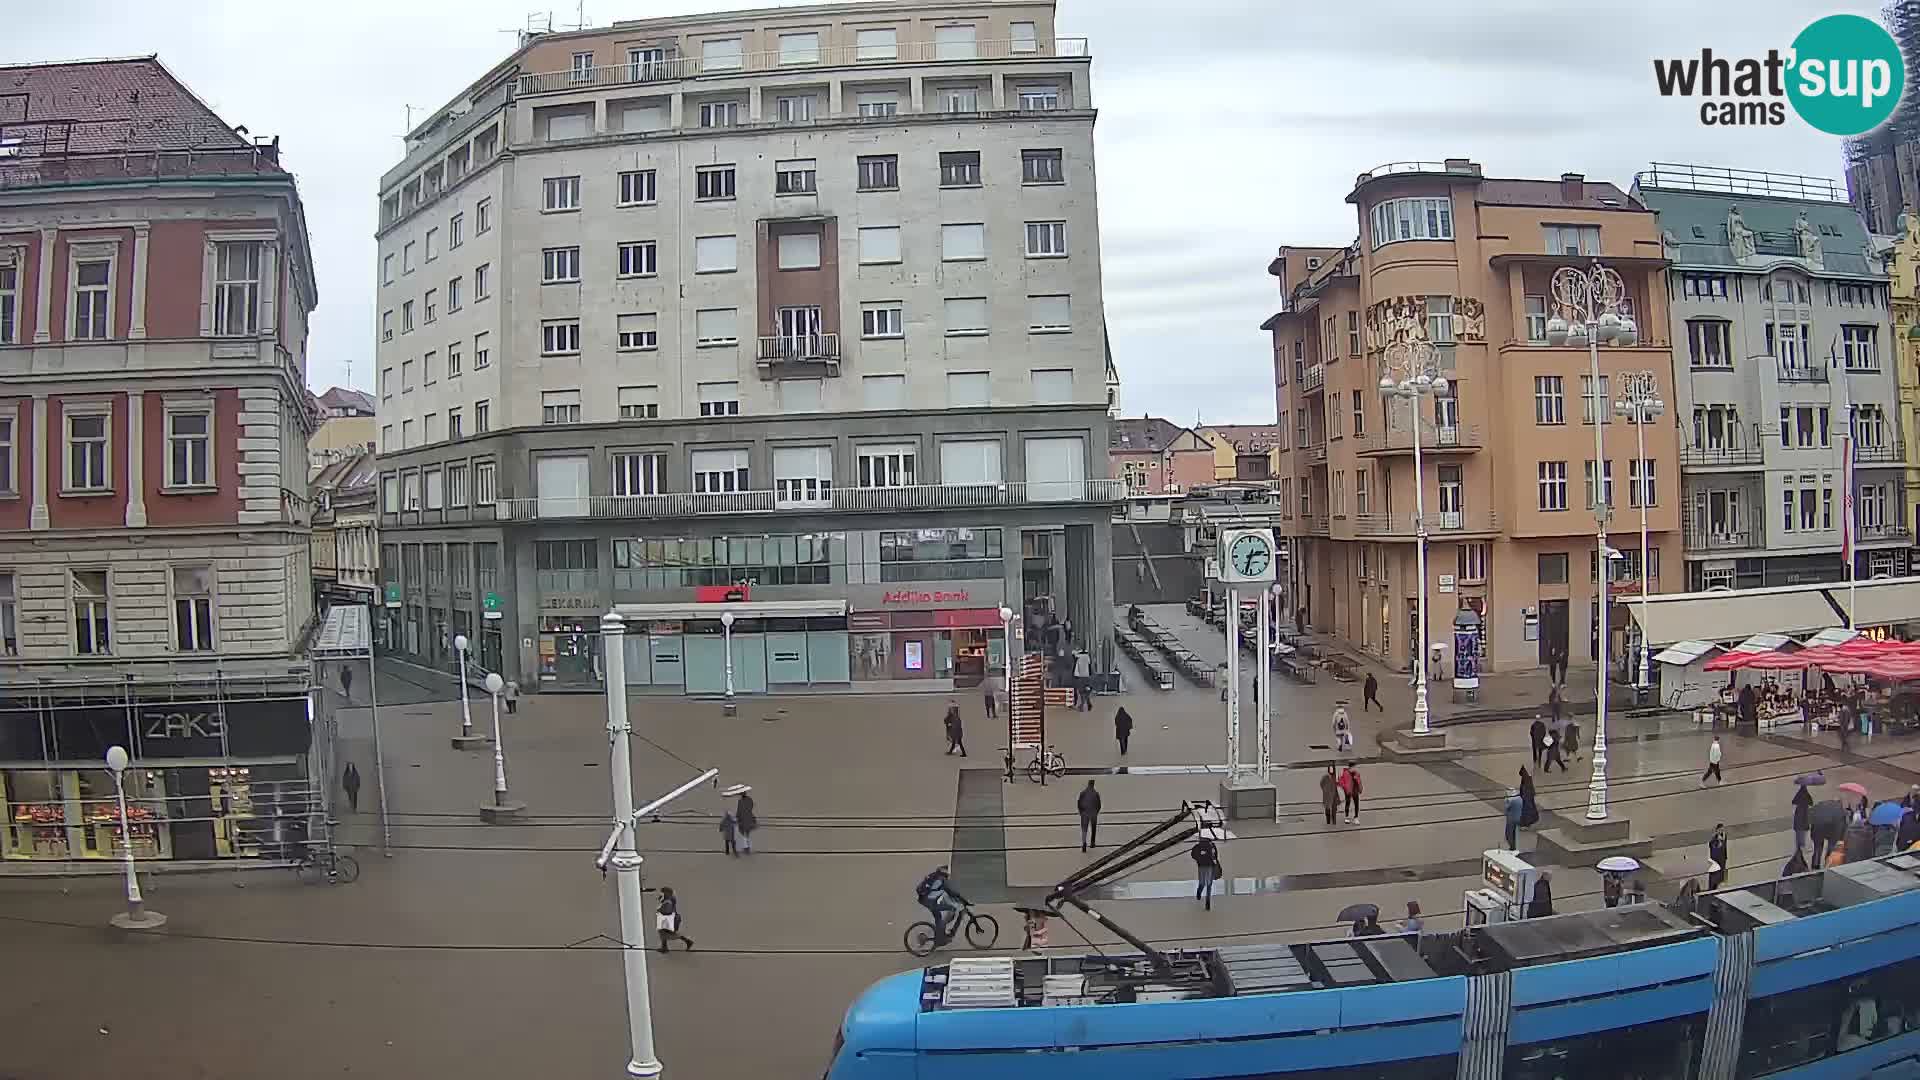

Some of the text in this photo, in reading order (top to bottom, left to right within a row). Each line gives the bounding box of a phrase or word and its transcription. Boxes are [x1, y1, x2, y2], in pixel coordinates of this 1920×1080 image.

[881, 588, 969, 603] Addiko Bank
[143, 712, 228, 738] ZAKS
